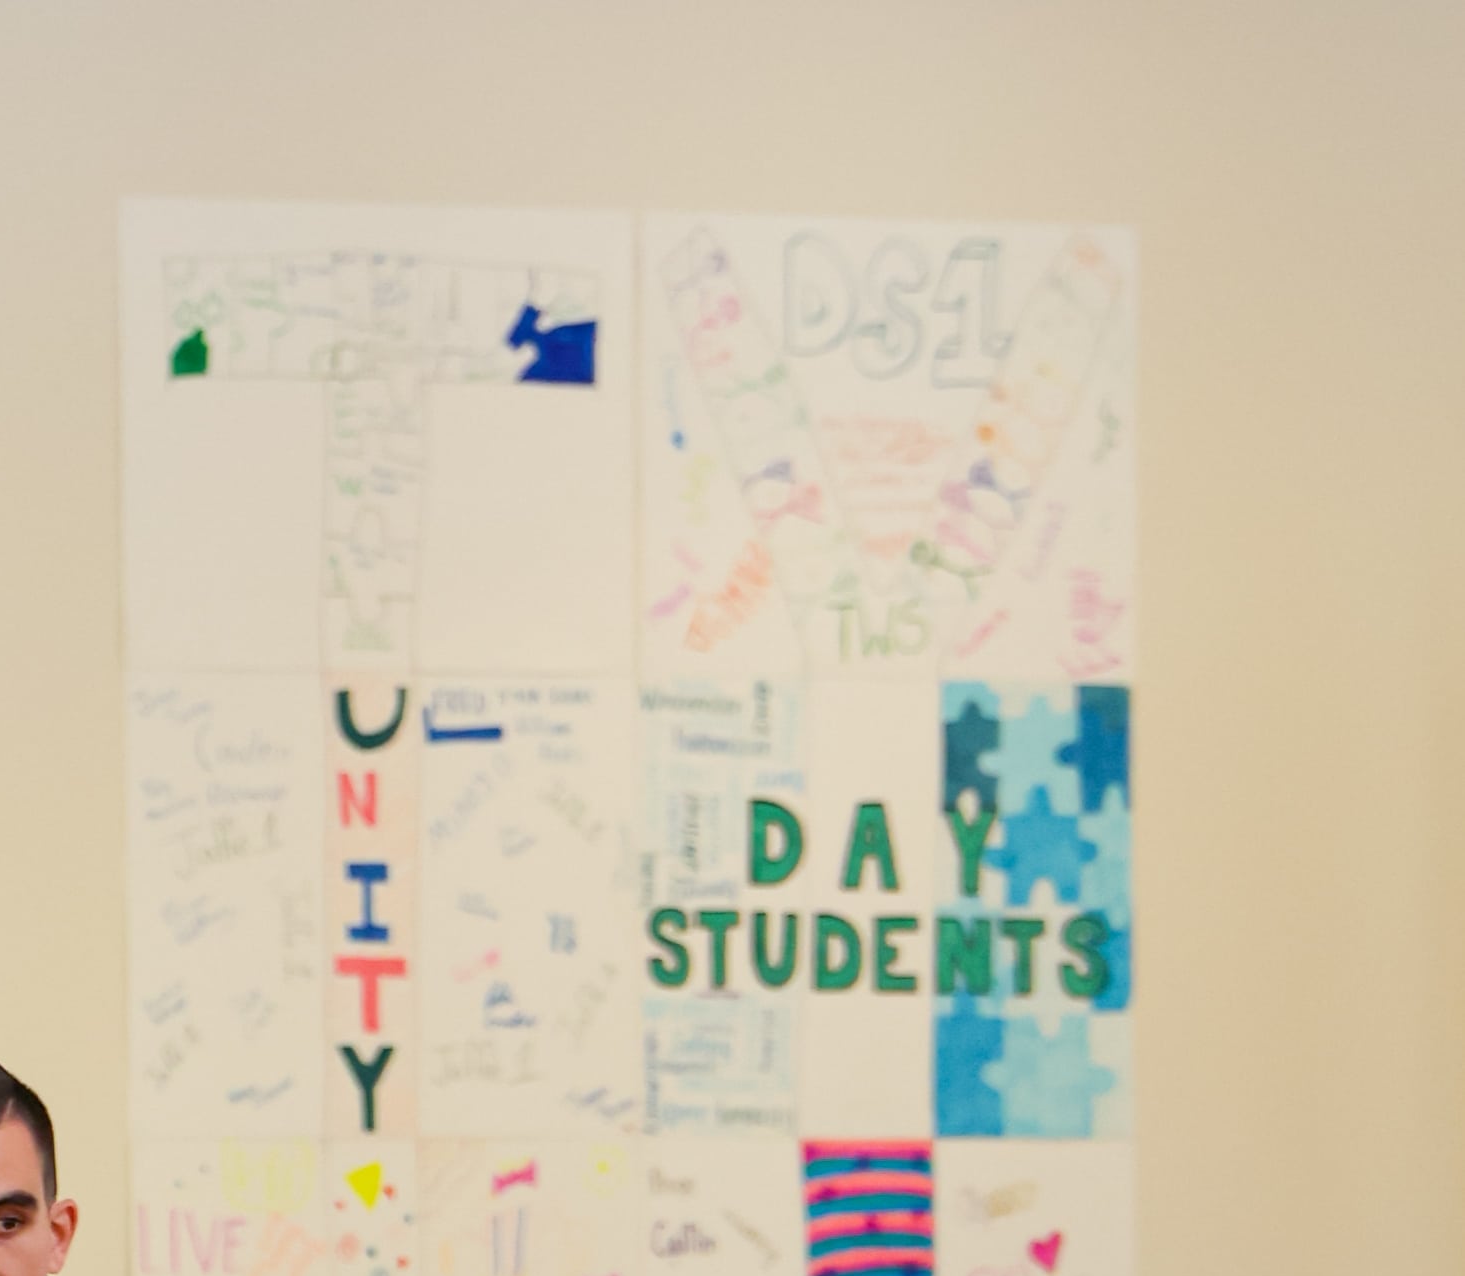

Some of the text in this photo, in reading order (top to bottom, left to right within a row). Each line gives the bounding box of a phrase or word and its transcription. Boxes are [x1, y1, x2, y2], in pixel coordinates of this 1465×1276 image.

[747, 796, 998, 899] DAY
[334, 685, 410, 1134] UNITY
[646, 906, 1110, 1000] STUDENTS
